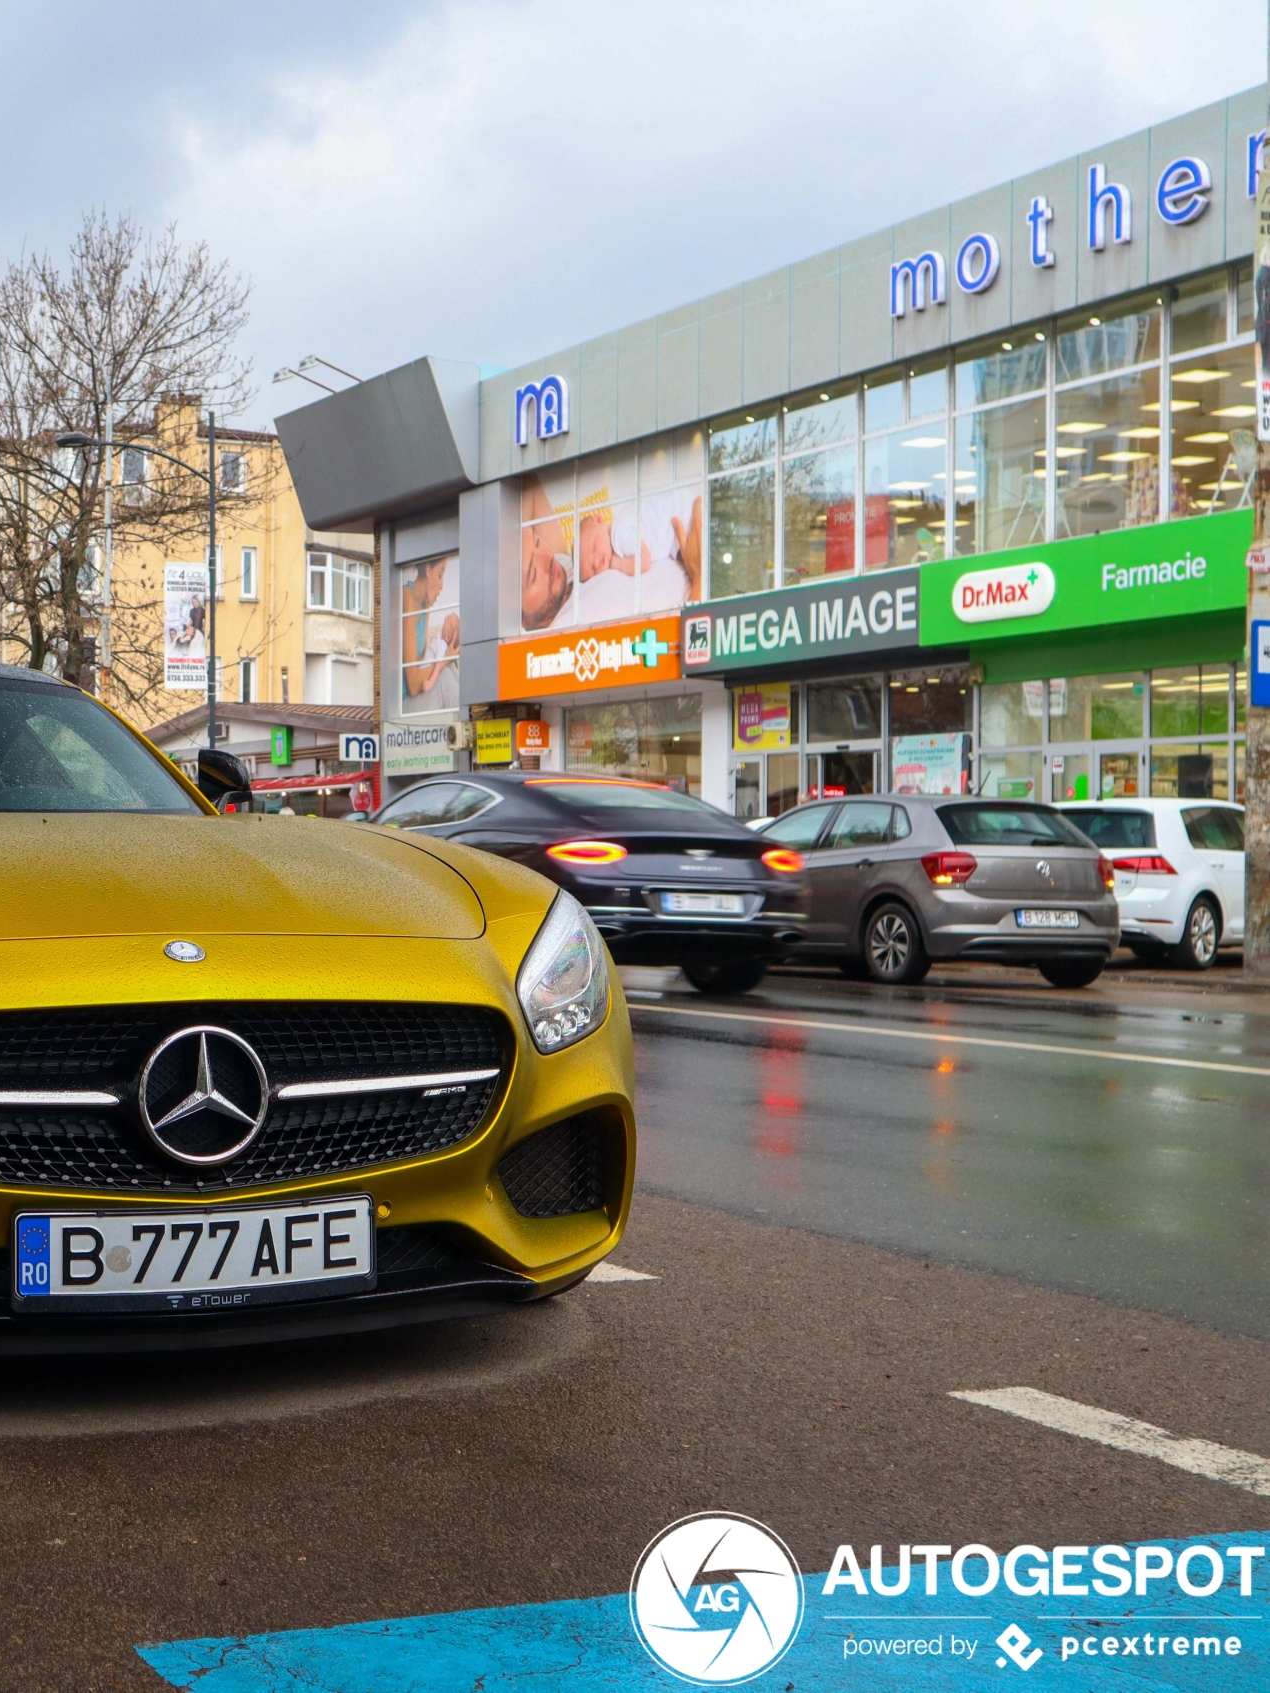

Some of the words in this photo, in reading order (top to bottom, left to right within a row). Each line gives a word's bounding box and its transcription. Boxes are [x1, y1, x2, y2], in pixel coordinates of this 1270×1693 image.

[1102, 551, 1207, 591] Farmacie
[715, 606, 803, 656] MEGA
[810, 586, 918, 643] IMAGE
[599, 640, 622, 673] Help
[741, 703, 759, 714] MEGA
[386, 726, 447, 748] mothercare
[386, 757, 402, 770] early
[403, 755, 429, 769] learning
[430, 753, 451, 765] centre
[1025, 911, 1033, 922] B
[1035, 911, 1052, 922] 128
[62, 1227, 105, 1286] B
[132, 1220, 240, 1284] 777
[251, 1209, 358, 1278] AFE
[22, 1262, 48, 1286] RO
[191, 1293, 252, 1307] eTower
